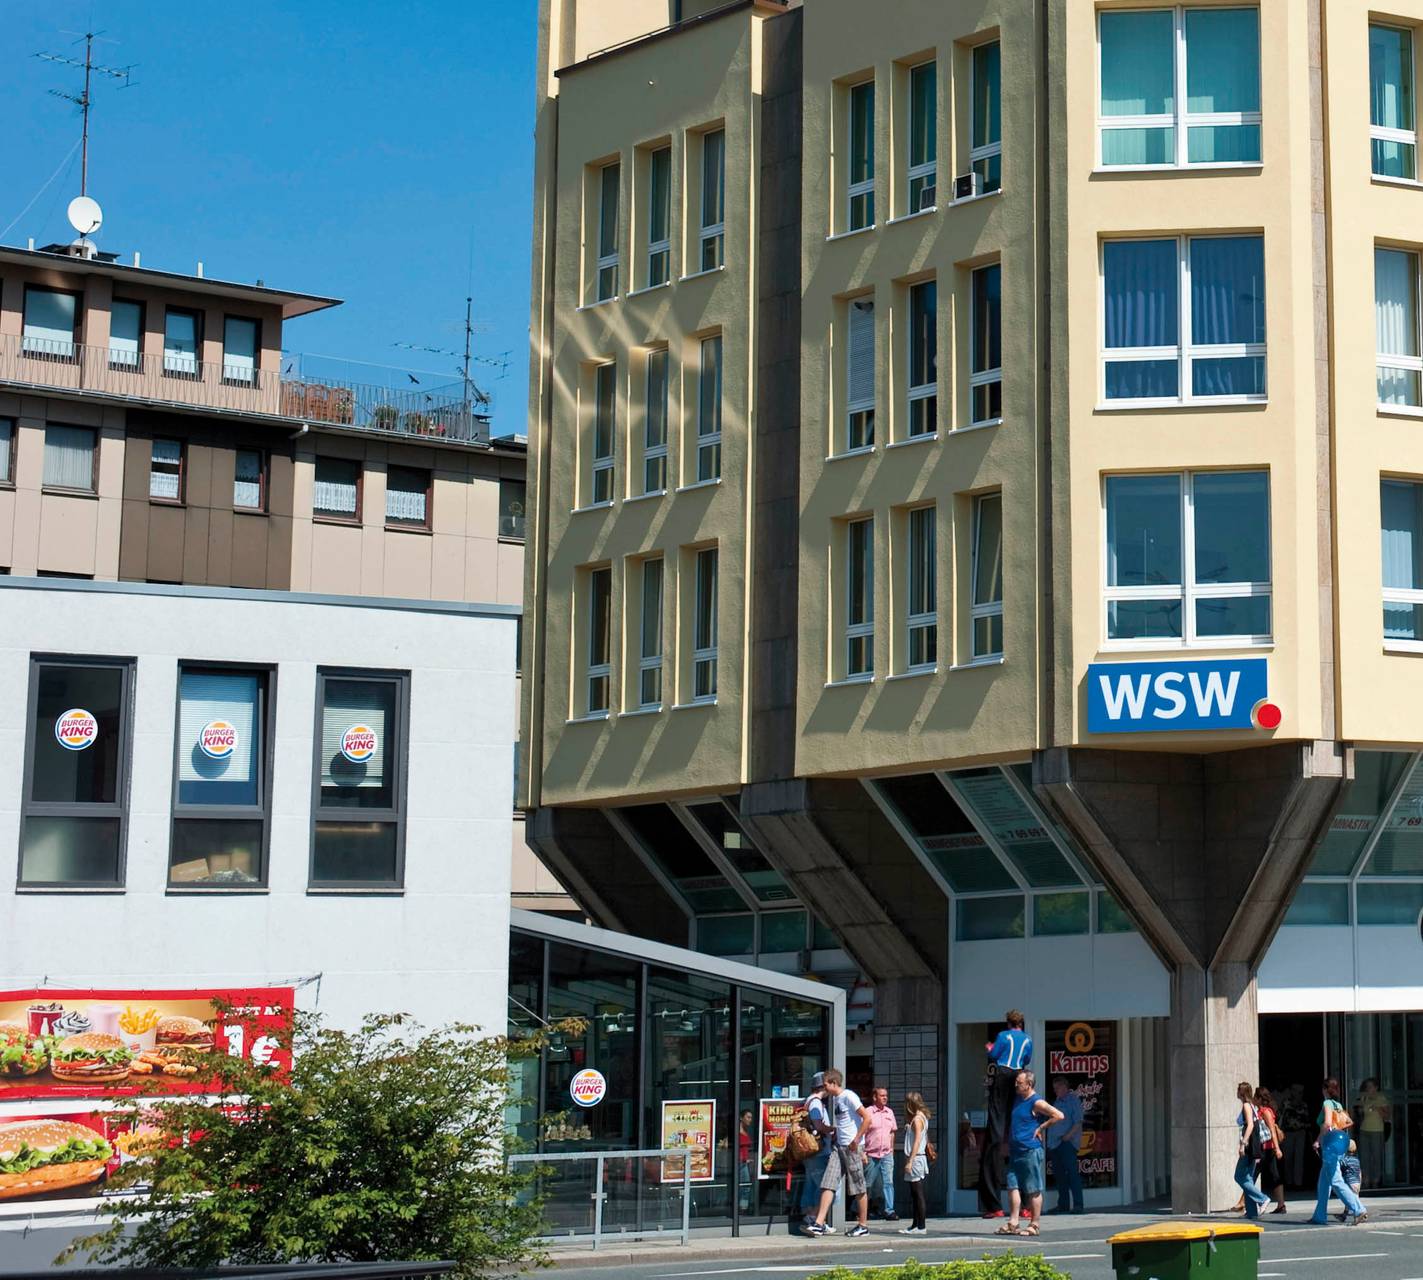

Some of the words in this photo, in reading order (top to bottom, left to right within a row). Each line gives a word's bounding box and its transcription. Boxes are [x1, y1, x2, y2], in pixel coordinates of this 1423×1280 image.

[1099, 671, 1241, 720] WSW
[61, 719, 94, 727] BURGER
[60, 727, 93, 737] KING
[204, 728, 235, 737] BURGER
[345, 733, 375, 741] BURGER
[203, 736, 235, 746] KING
[345, 740, 375, 751] KING
[1050, 1051, 1109, 1078] Kamps
[575, 1078, 604, 1086] BURGER
[574, 1085, 602, 1095] KING
[768, 1105, 794, 1115] KING
